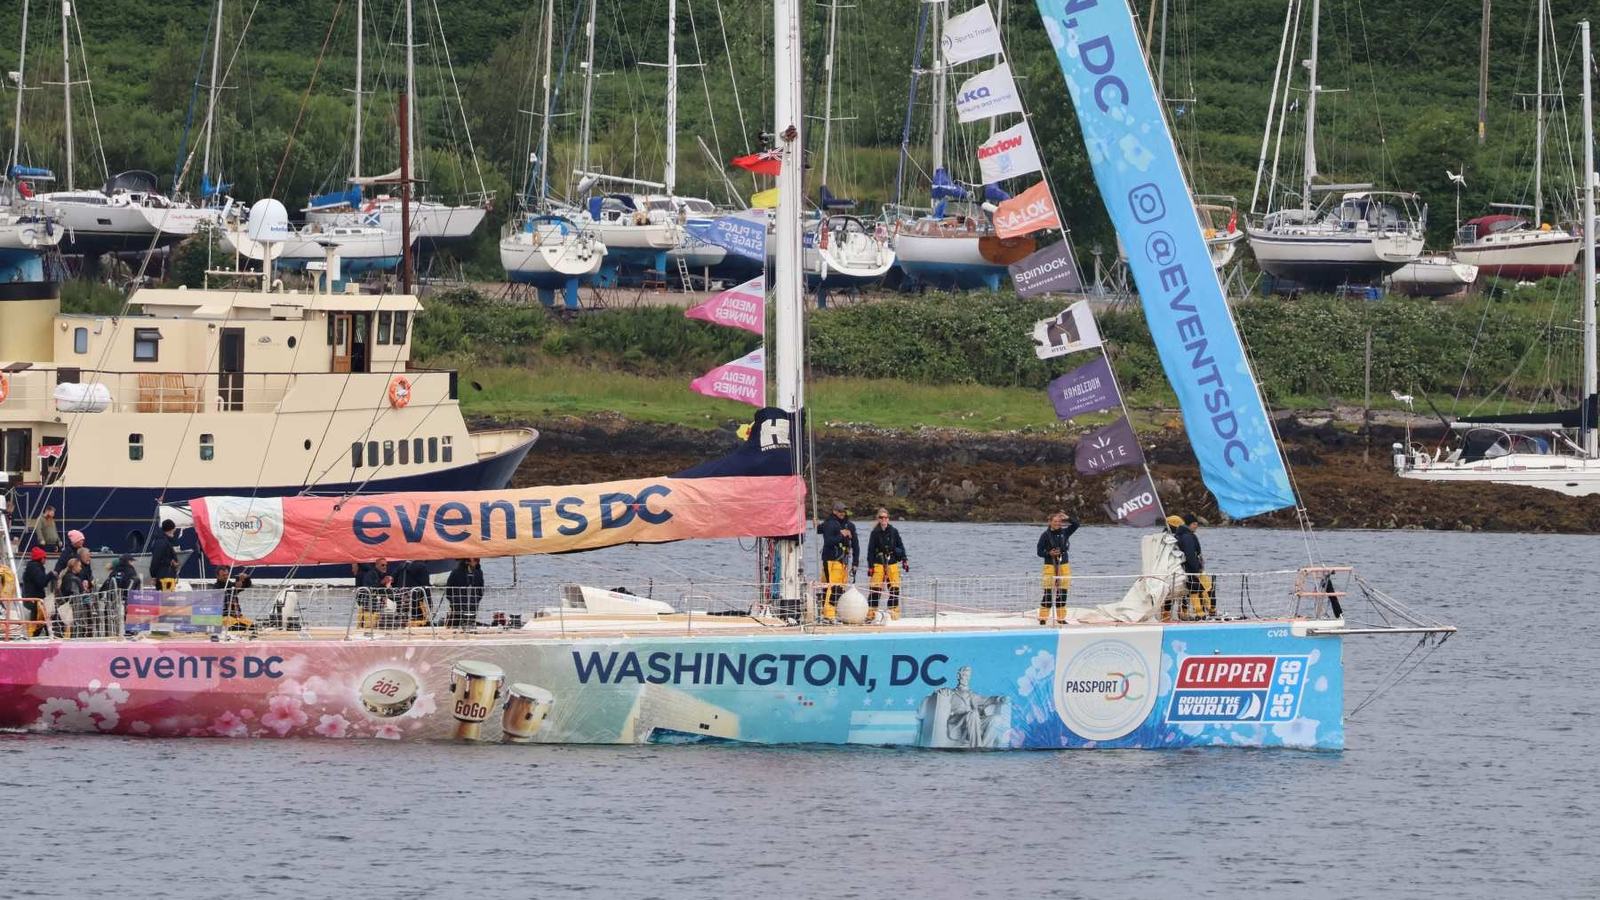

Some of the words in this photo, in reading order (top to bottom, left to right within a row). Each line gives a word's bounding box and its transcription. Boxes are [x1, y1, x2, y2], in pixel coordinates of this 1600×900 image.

[1078, 35, 1129, 113] DC
[996, 198, 1050, 227] SA-LOK
[1146, 230, 1250, 468] @EVENTSDC
[1063, 376, 1102, 400] HAMBLEDON
[1088, 445, 1127, 469] NITE
[599, 484, 673, 530] DC
[1267, 629, 1288, 638] CV26
[243, 656, 284, 679] DC
[573, 650, 877, 692] WASHINGTON,
[889, 653, 949, 687] DC
[1185, 663, 1268, 683] CLIPPER
[372, 680, 401, 697] 202
[1066, 680, 1118, 694] PASSPORT
[1270, 660, 1302, 718] 25-26
[1178, 704, 1239, 716] WORLD
[1180, 696, 1219, 704] ROUND
[1220, 696, 1241, 704] THE
